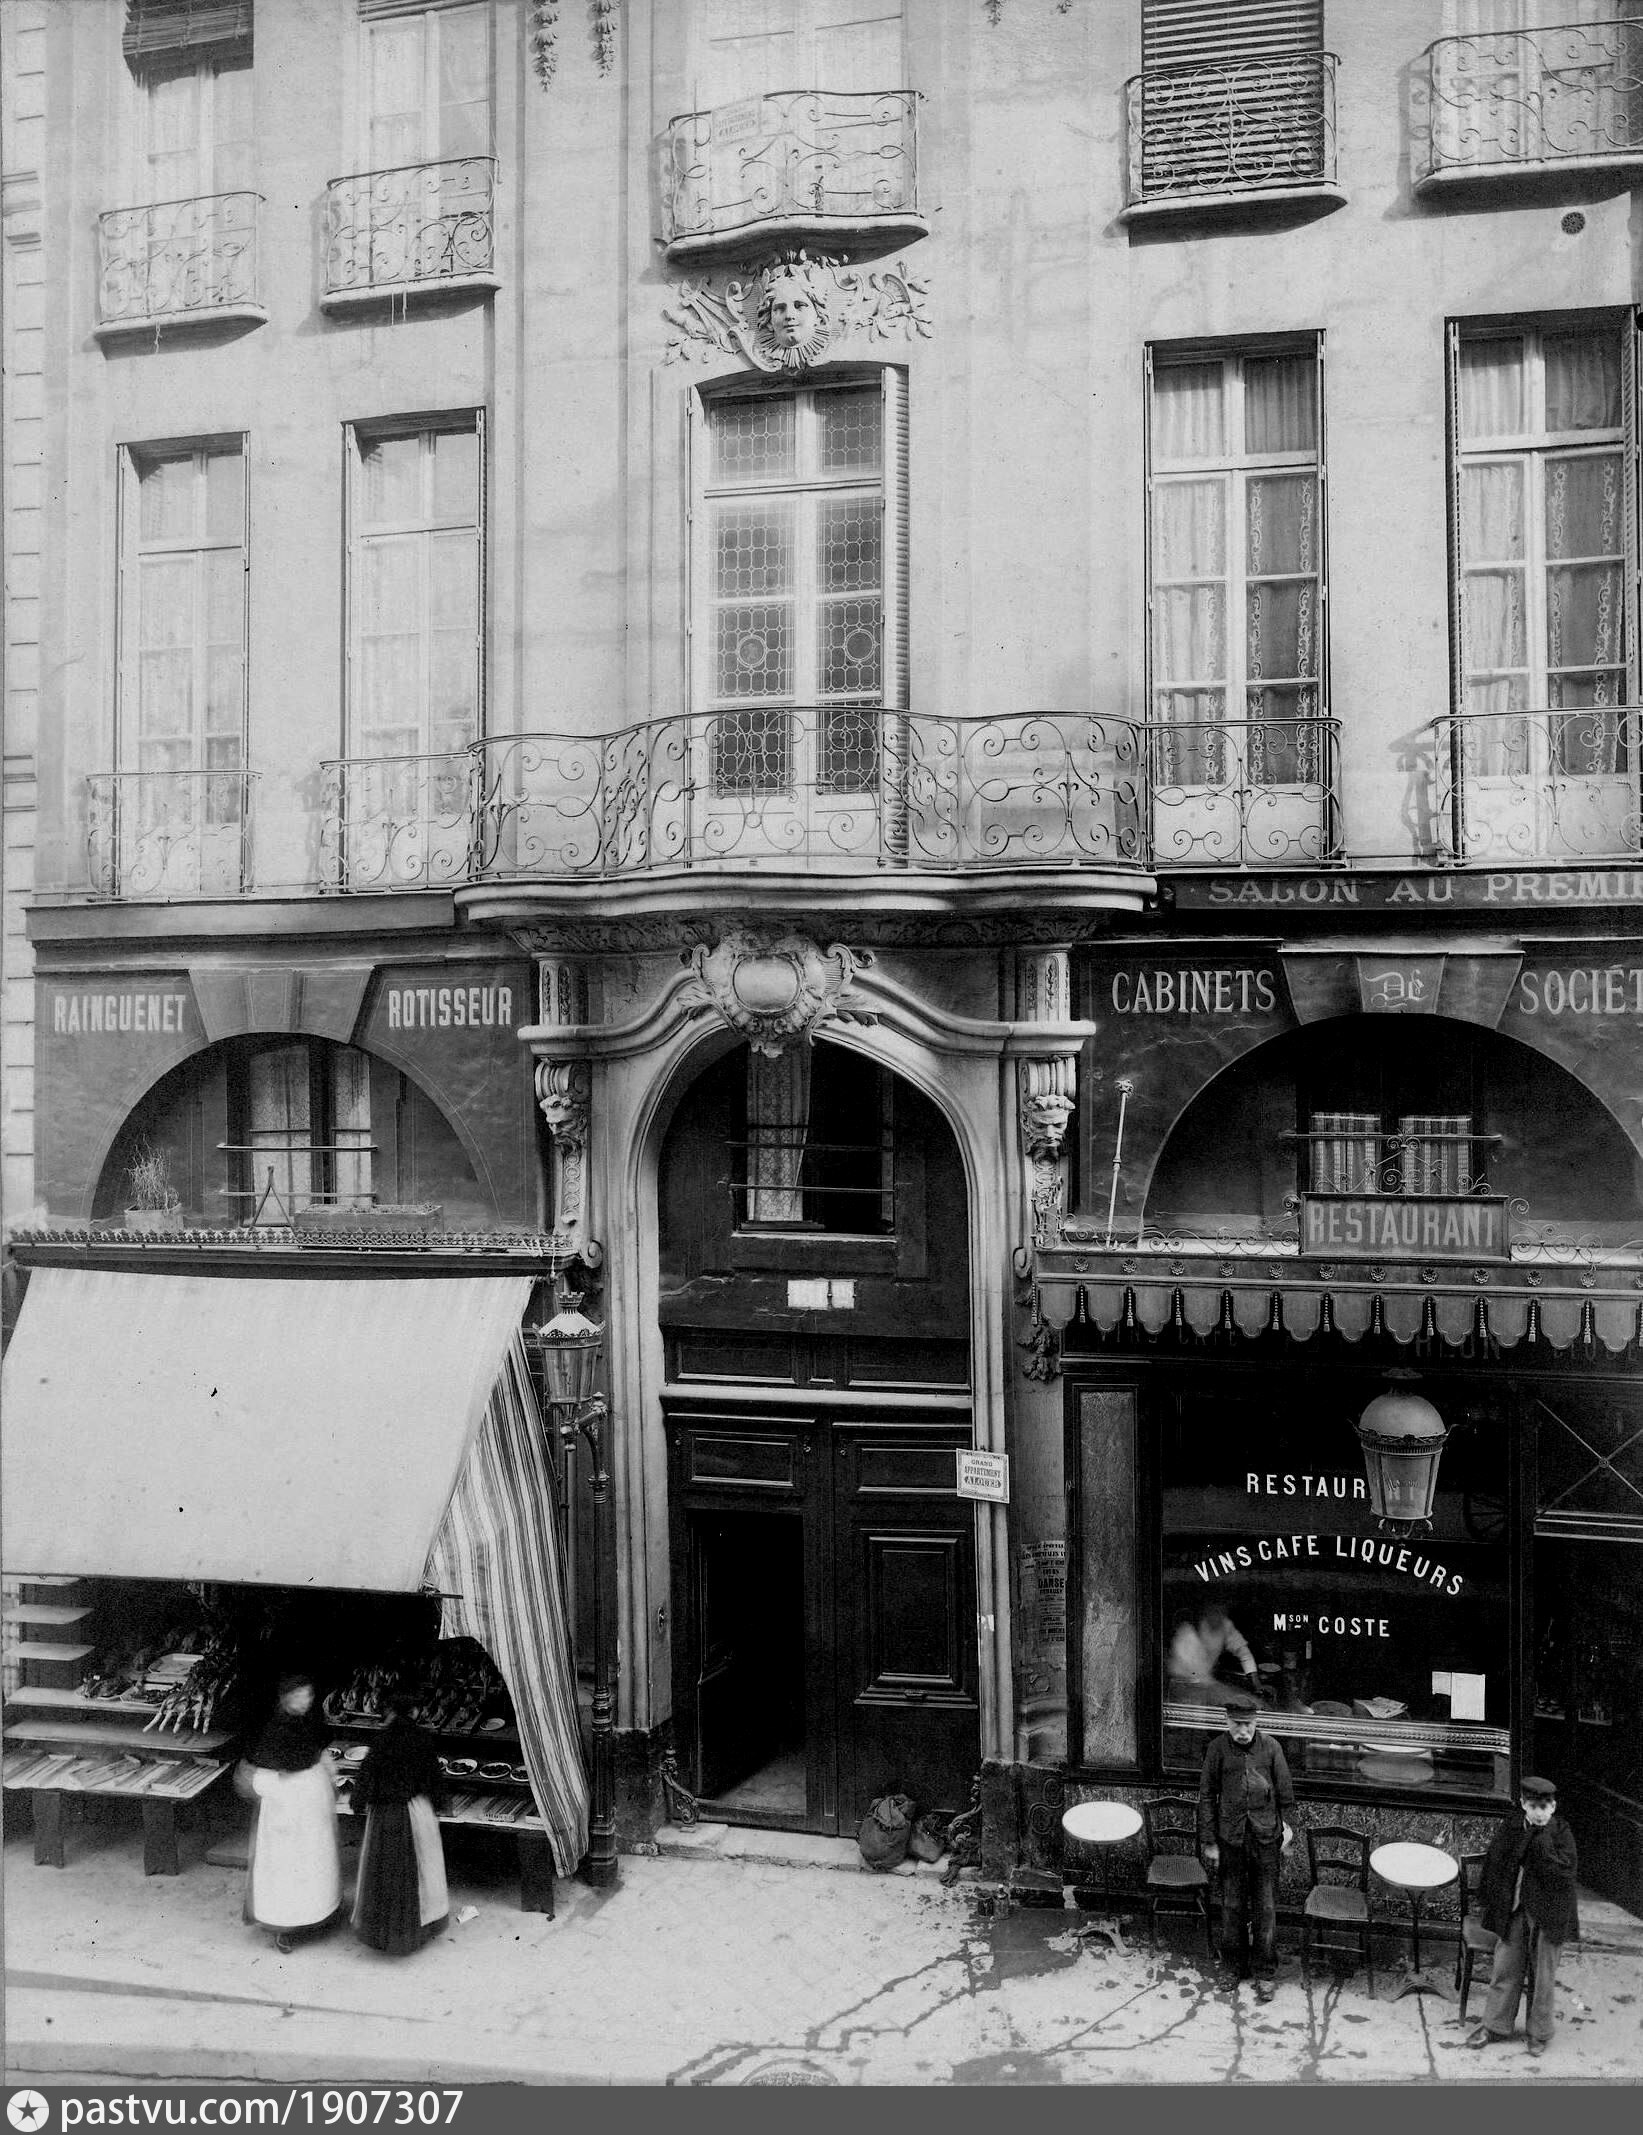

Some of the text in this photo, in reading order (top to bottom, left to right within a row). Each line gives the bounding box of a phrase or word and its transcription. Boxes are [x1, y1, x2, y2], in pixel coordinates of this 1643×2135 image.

[1208, 880, 1360, 904] SALON
[1386, 878, 1456, 904] AU
[53, 986, 513, 1034] RAINGUENET ROTISSEUR
[1111, 969, 1276, 1015] CABINETS
[1309, 1203, 1494, 1247] RESTAURANT
[1247, 1473, 1370, 1499] RESTAUR
[1194, 1535, 1463, 1595] VINS CAFE LIQUEURS
[1318, 1616, 1390, 1637] COSTE
